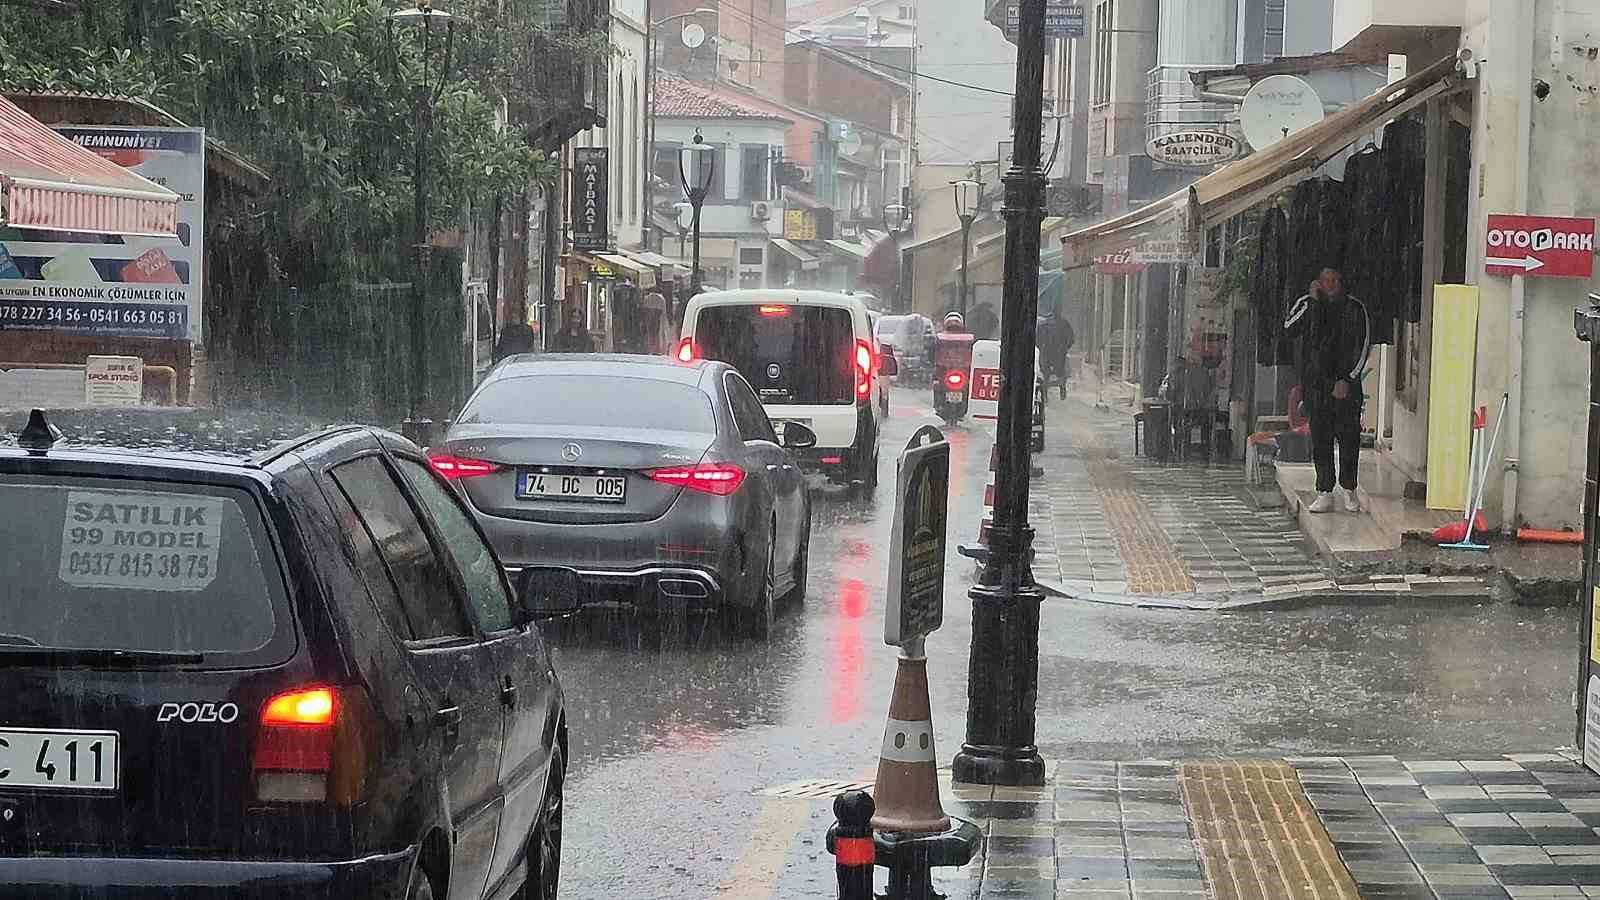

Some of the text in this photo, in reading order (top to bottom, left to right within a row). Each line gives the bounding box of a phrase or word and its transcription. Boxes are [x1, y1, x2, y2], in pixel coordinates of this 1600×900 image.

[73, 132, 161, 148] MEMNUNİYET
[1153, 133, 1234, 149] KALENDER
[1165, 145, 1221, 156] SAATÇİLİK
[584, 164, 597, 232] MATBAASI
[1487, 228, 1593, 251] OTOPARK
[32, 286, 46, 297] EN
[49, 285, 104, 298] EKONOMİK
[108, 287, 161, 301] ÇÖZÜMLER
[165, 287, 185, 303] İÇİN
[0, 306, 18, 319] 78
[21, 307, 43, 319] 227
[47, 307, 62, 320] 34
[123, 310, 146, 324] 663
[149, 310, 165, 324] 05
[168, 311, 183, 325] 81
[981, 374, 1000, 387] TE
[979, 389, 998, 398] BU
[527, 474, 623, 497] 74 DC 005
[72, 502, 207, 526] SATILIK
[71, 526, 211, 549] 99 MODEL
[70, 550, 209, 578] 0537 815 38 75
[157, 702, 239, 723] POLO
[35, 739, 102, 782] 411
